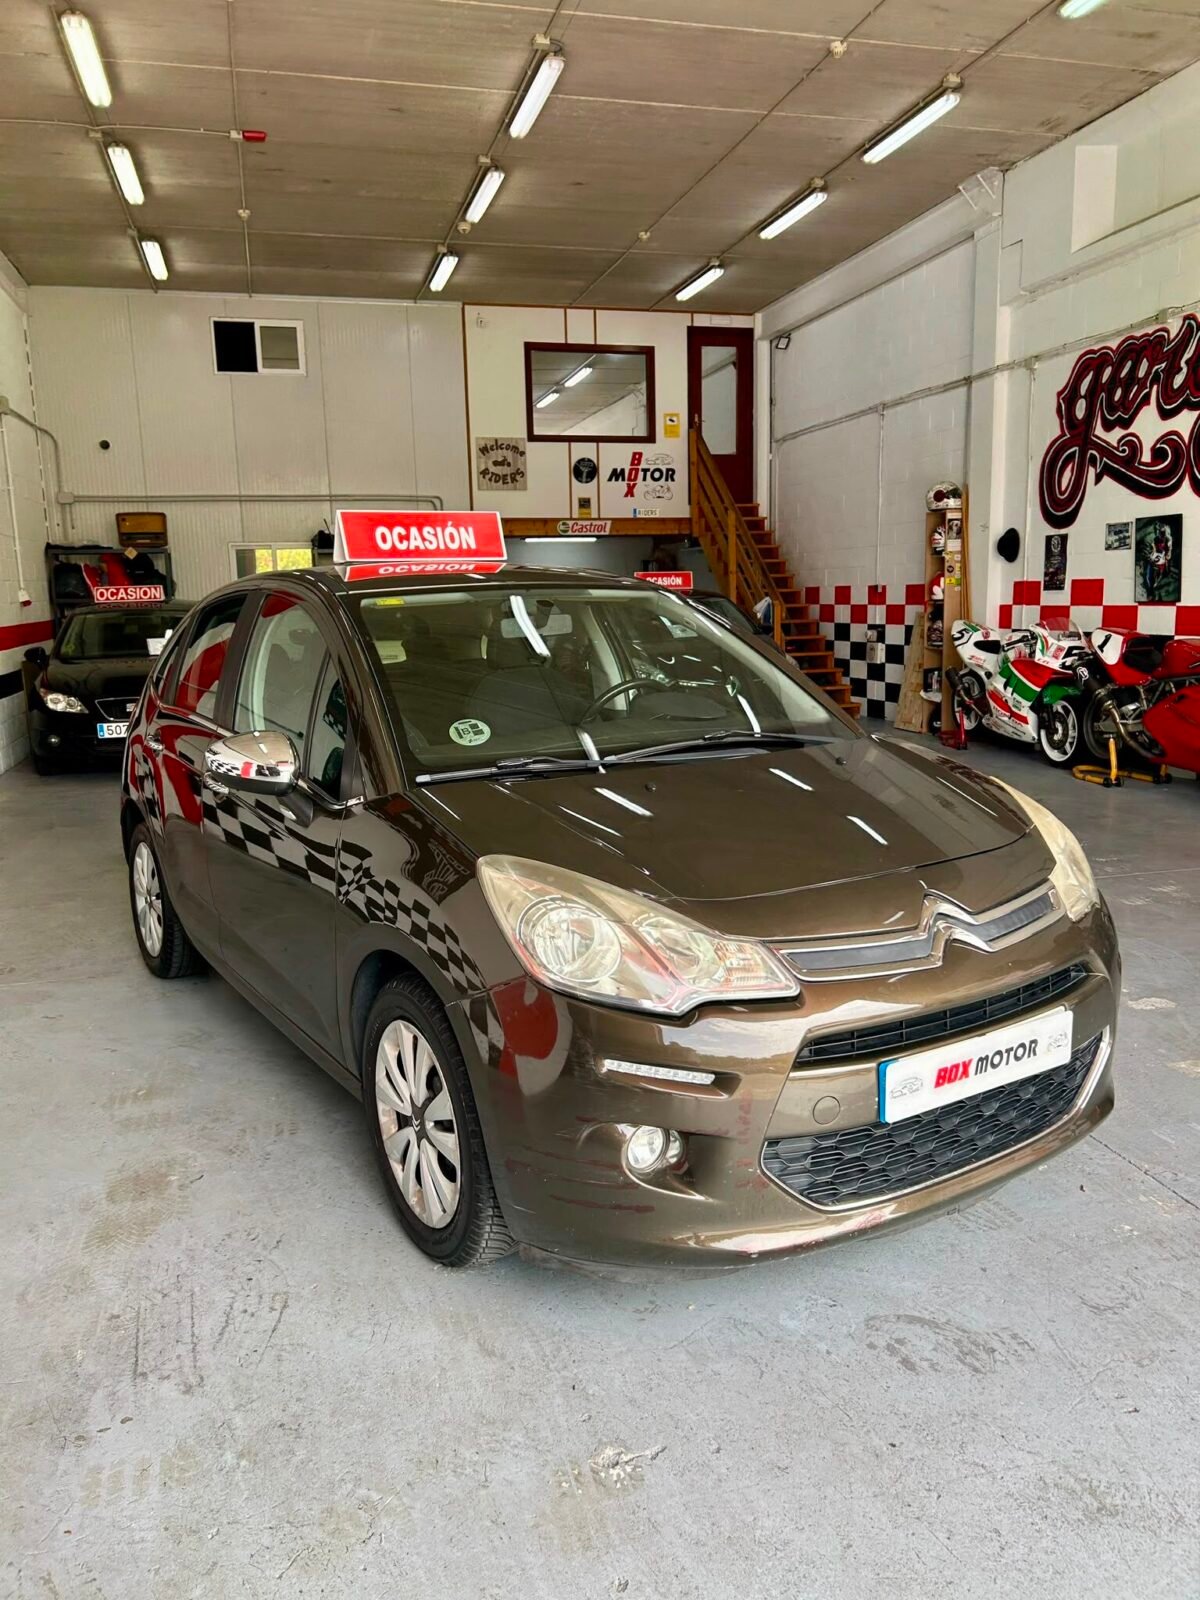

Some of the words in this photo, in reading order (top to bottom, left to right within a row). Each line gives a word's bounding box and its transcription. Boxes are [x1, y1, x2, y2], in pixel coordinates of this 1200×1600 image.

[479, 439, 526, 457] Welcome
[480, 467, 525, 485] RIDERS
[375, 521, 477, 550] OCASIÓN
[571, 522, 608, 533] Castrol
[96, 588, 161, 601] OCASION
[1097, 634, 1113, 653] 1
[106, 725, 129, 736] 507
[934, 1059, 974, 1088] BOX
[975, 1039, 1038, 1076] MOTOR
